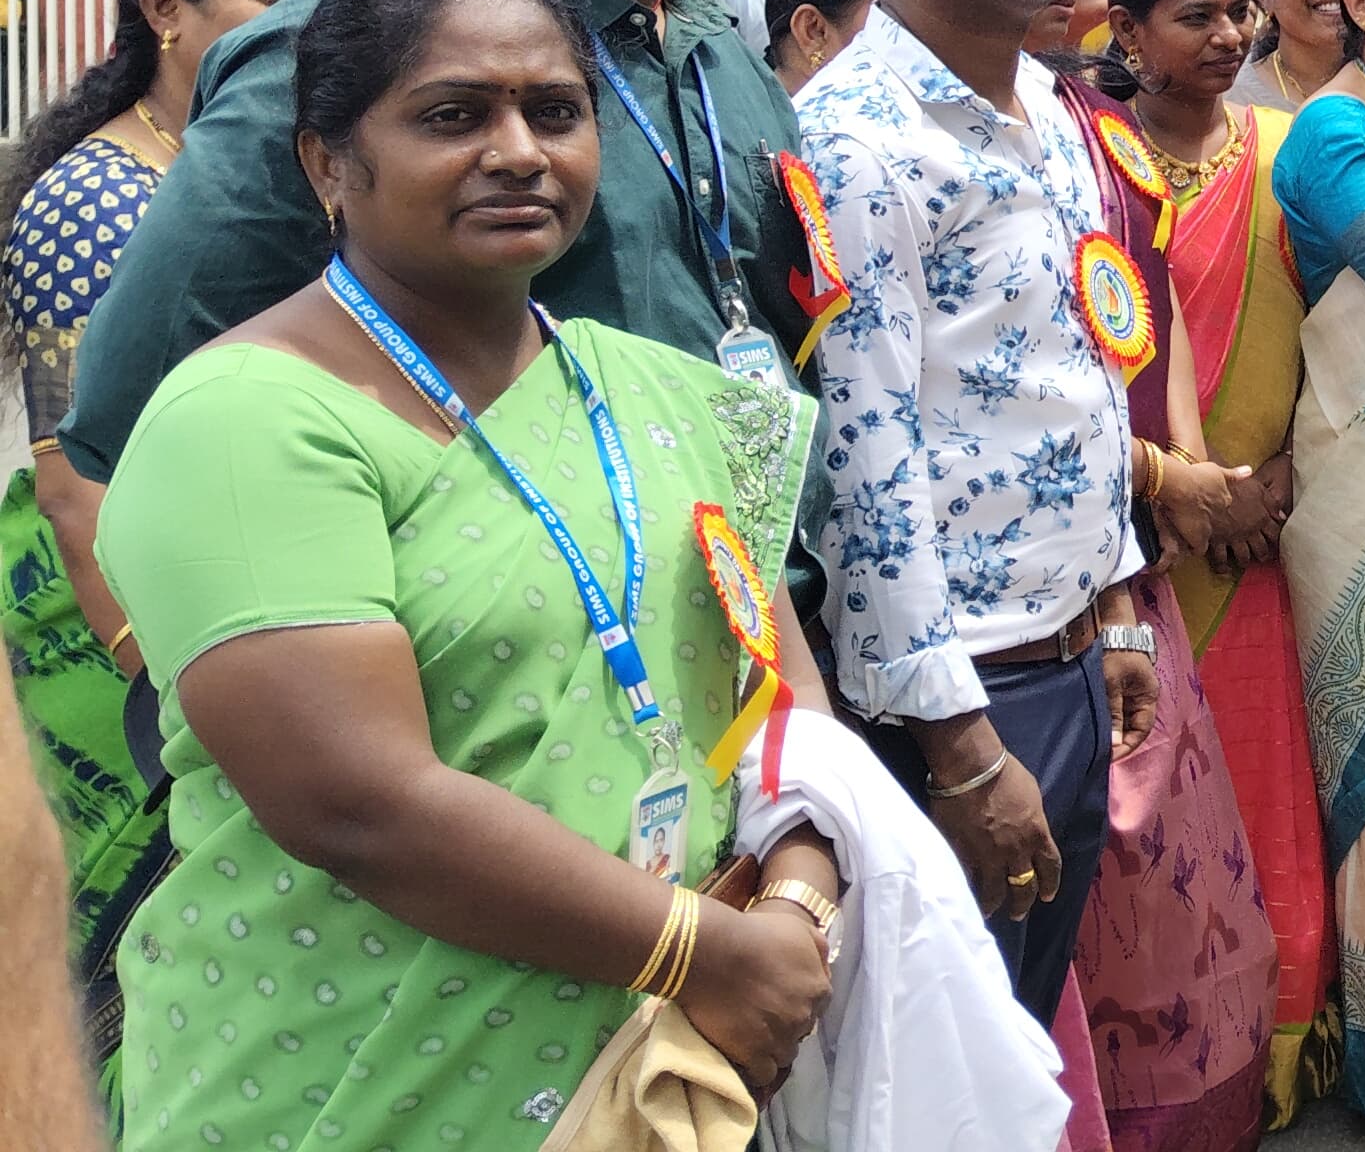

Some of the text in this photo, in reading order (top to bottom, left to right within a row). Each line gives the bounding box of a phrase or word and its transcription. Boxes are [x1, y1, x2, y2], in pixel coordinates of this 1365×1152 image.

[357, 303, 379, 321] OF
[373, 320, 417, 365] GROUP
[739, 347, 771, 364] SIMS
[412, 362, 447, 398] SIMS
[538, 503, 558, 525] OF
[553, 527, 591, 583] GROUP
[584, 586, 611, 626] SIMS
[652, 791, 684, 819] SIMS
